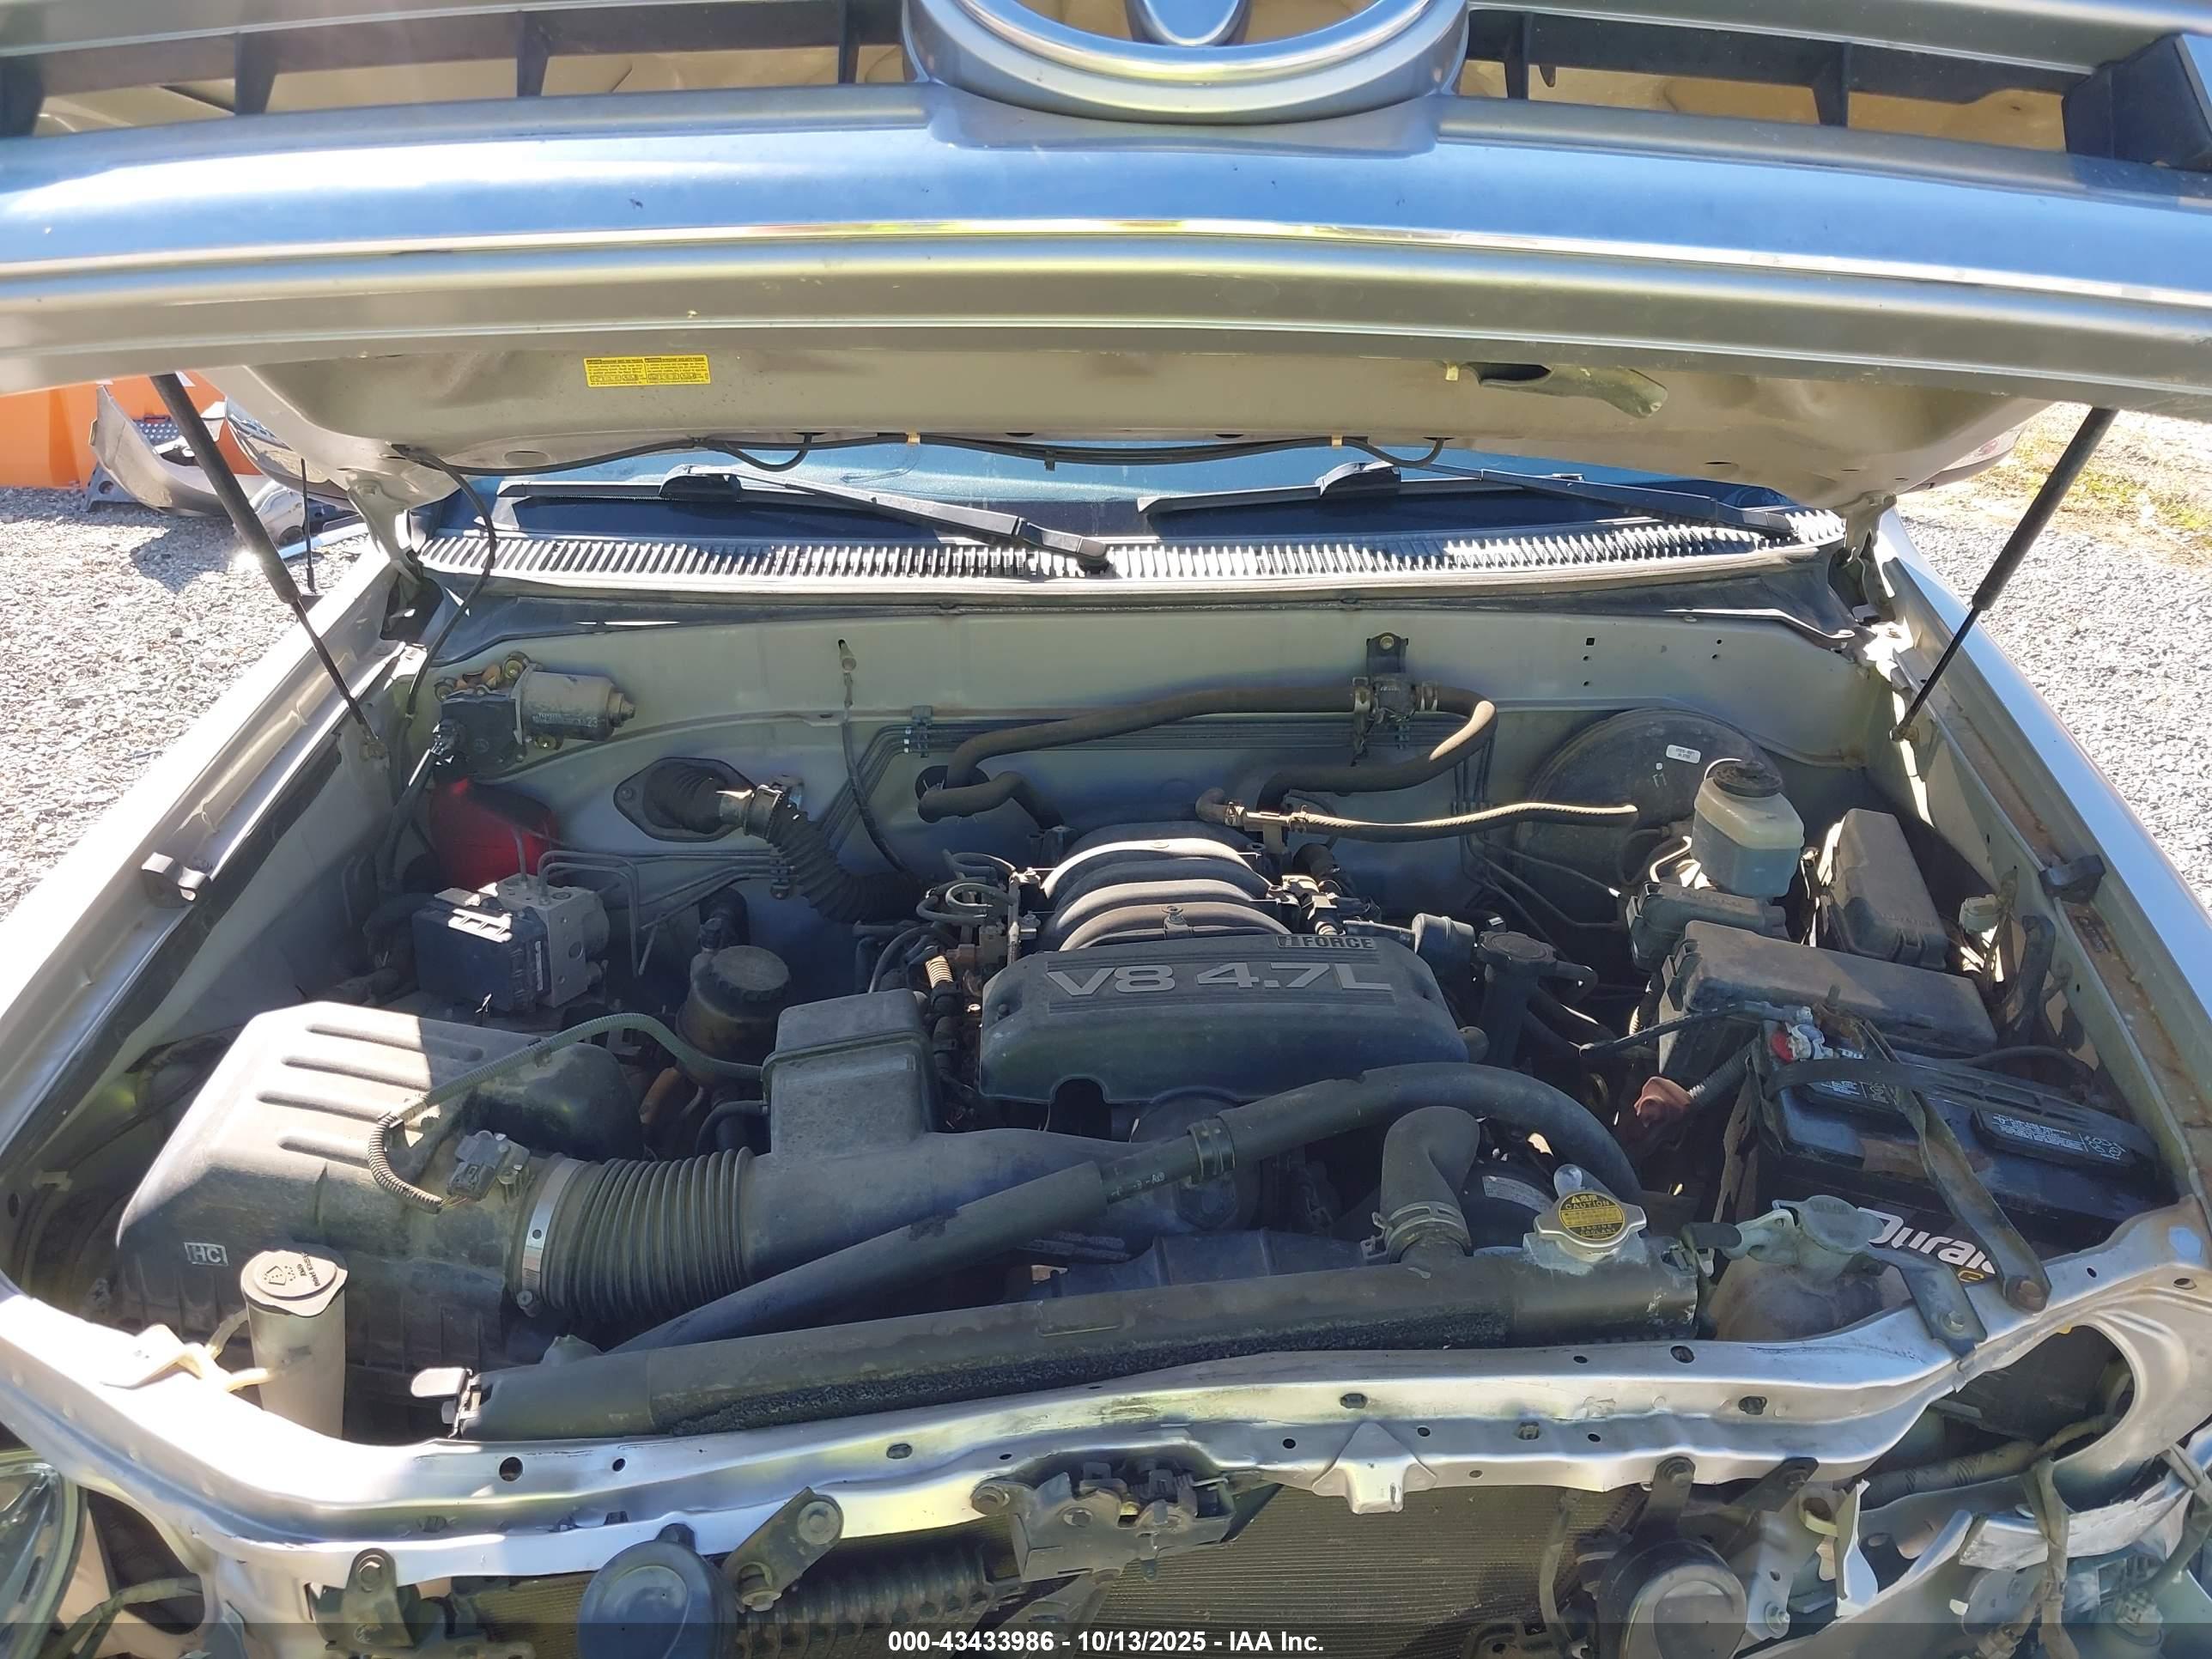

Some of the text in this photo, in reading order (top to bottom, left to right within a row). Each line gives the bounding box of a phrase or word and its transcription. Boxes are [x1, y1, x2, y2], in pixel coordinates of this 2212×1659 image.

[1046, 962, 1393, 996] V8 4.7L
[1565, 1200, 1610, 1210] CAUTION
[191, 1246, 221, 1263] HC
